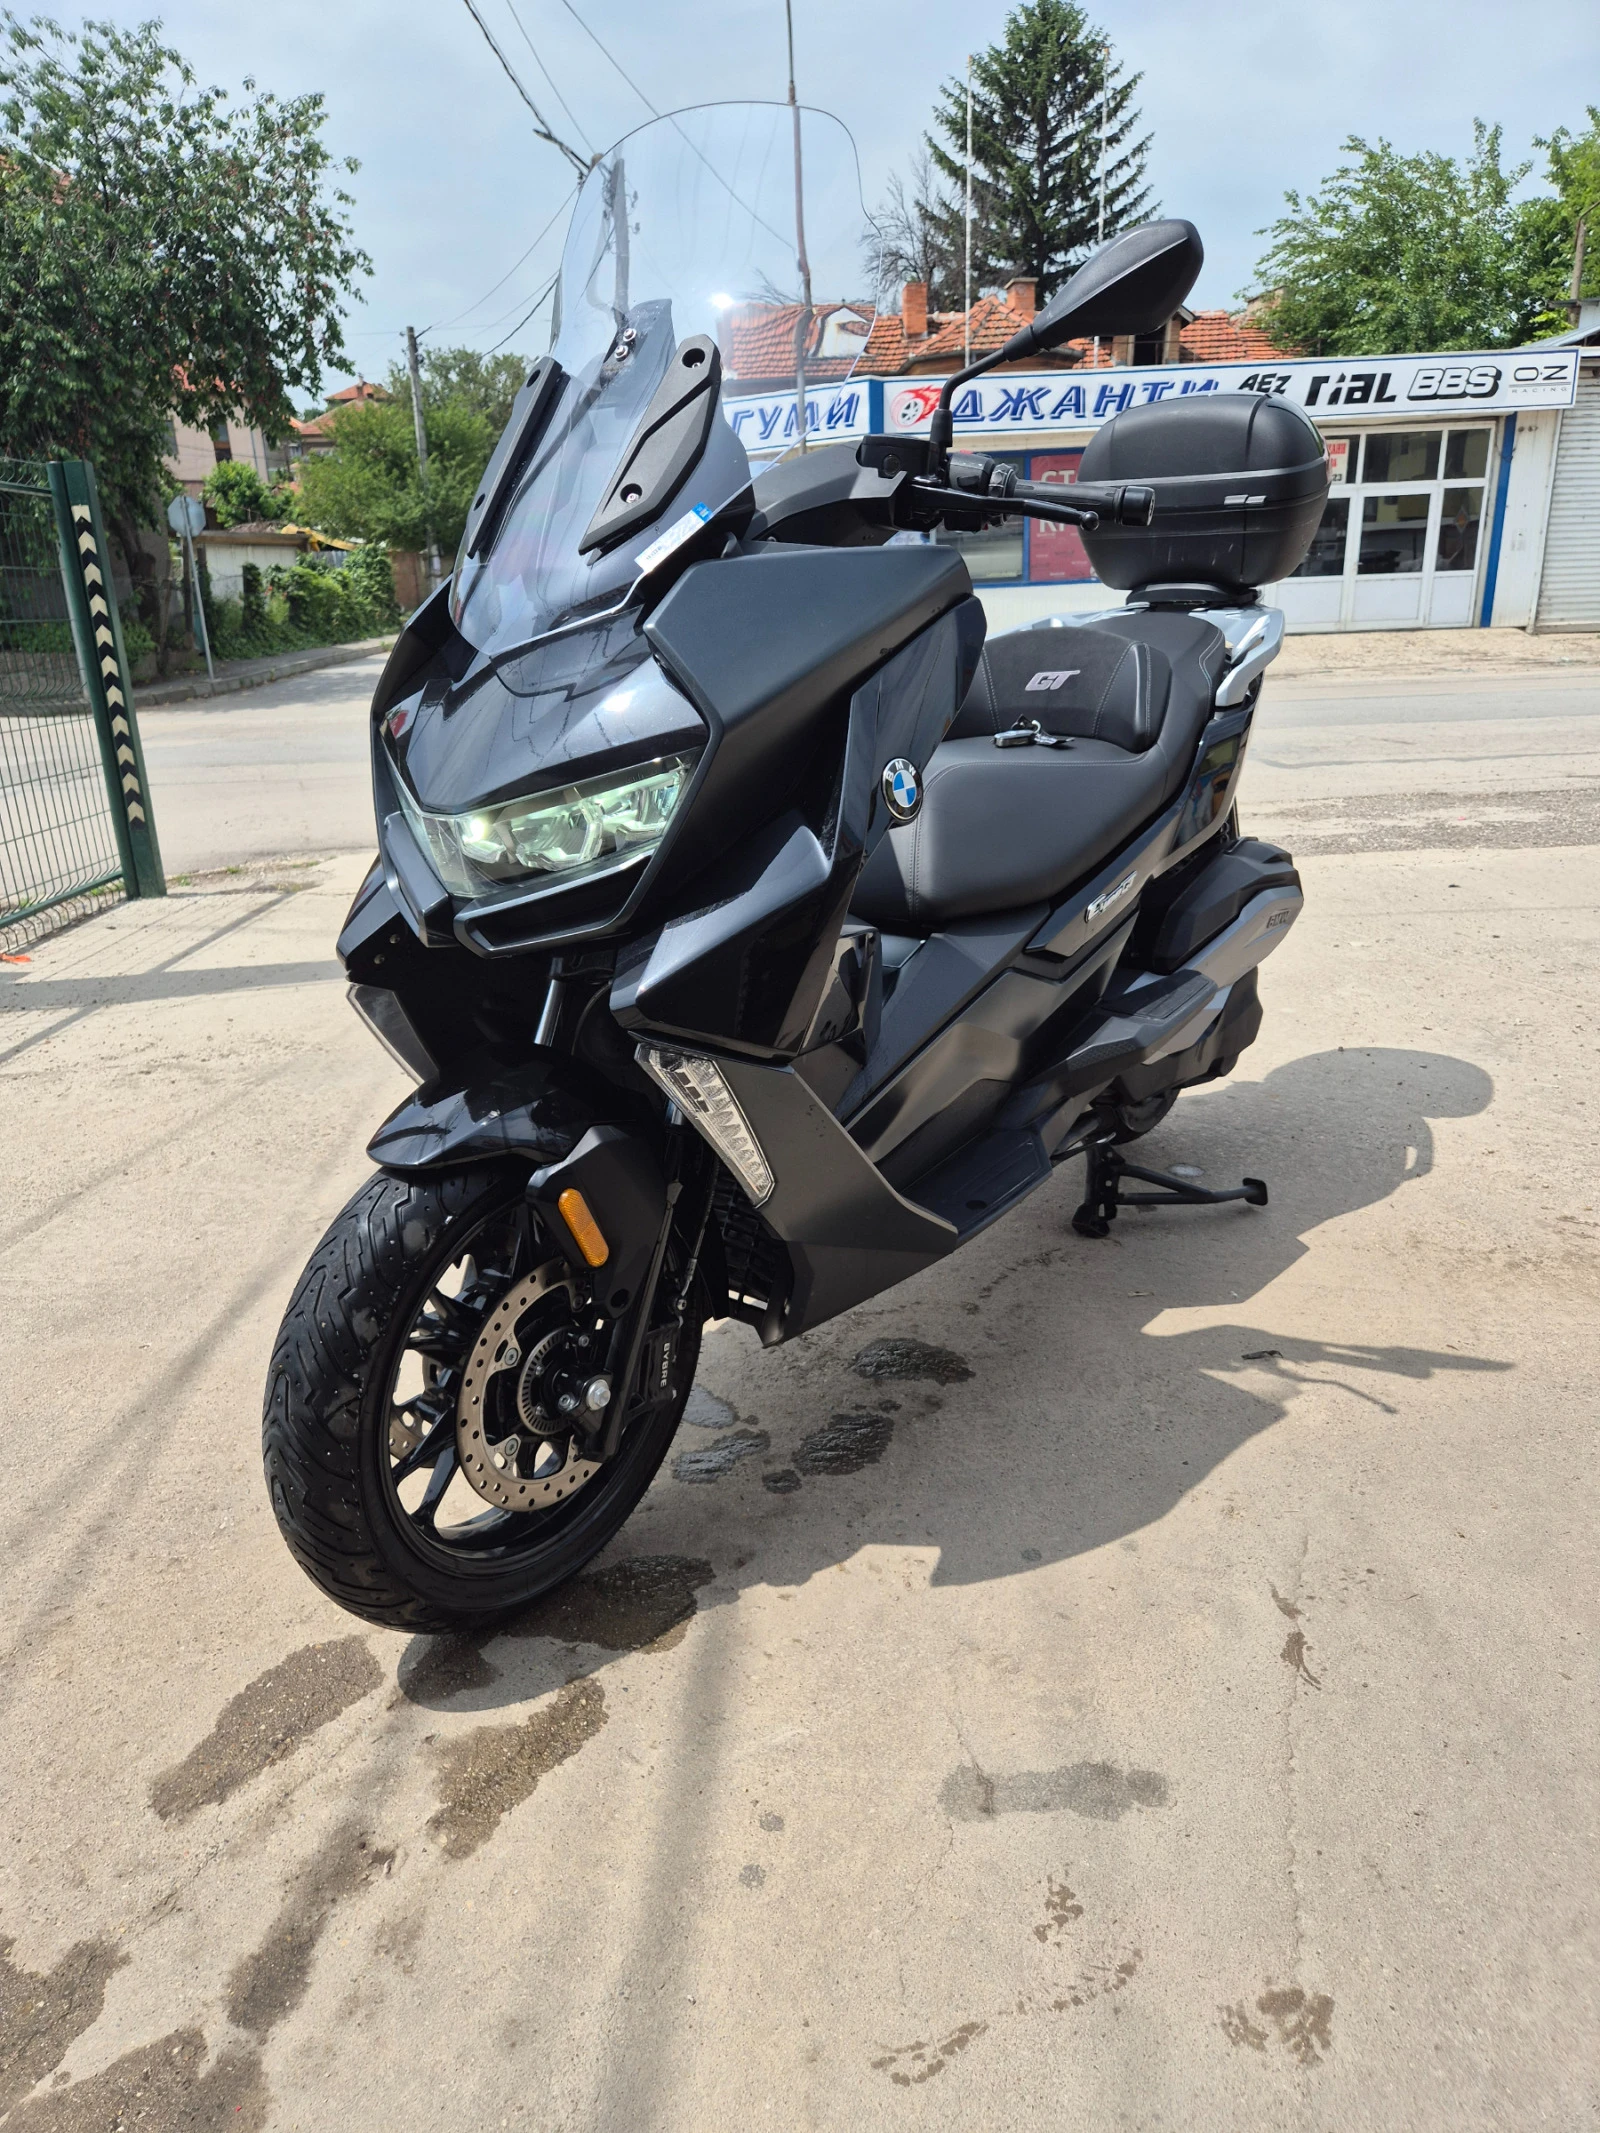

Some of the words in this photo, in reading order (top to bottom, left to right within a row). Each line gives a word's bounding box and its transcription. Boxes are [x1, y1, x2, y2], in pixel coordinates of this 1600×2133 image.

[1407, 365, 1503, 401] BBS
[732, 392, 860, 440] ГУМИ
[1024, 669, 1081, 691] GT
[885, 760, 917, 782] BMW
[660, 1342, 671, 1388] BYBRE
